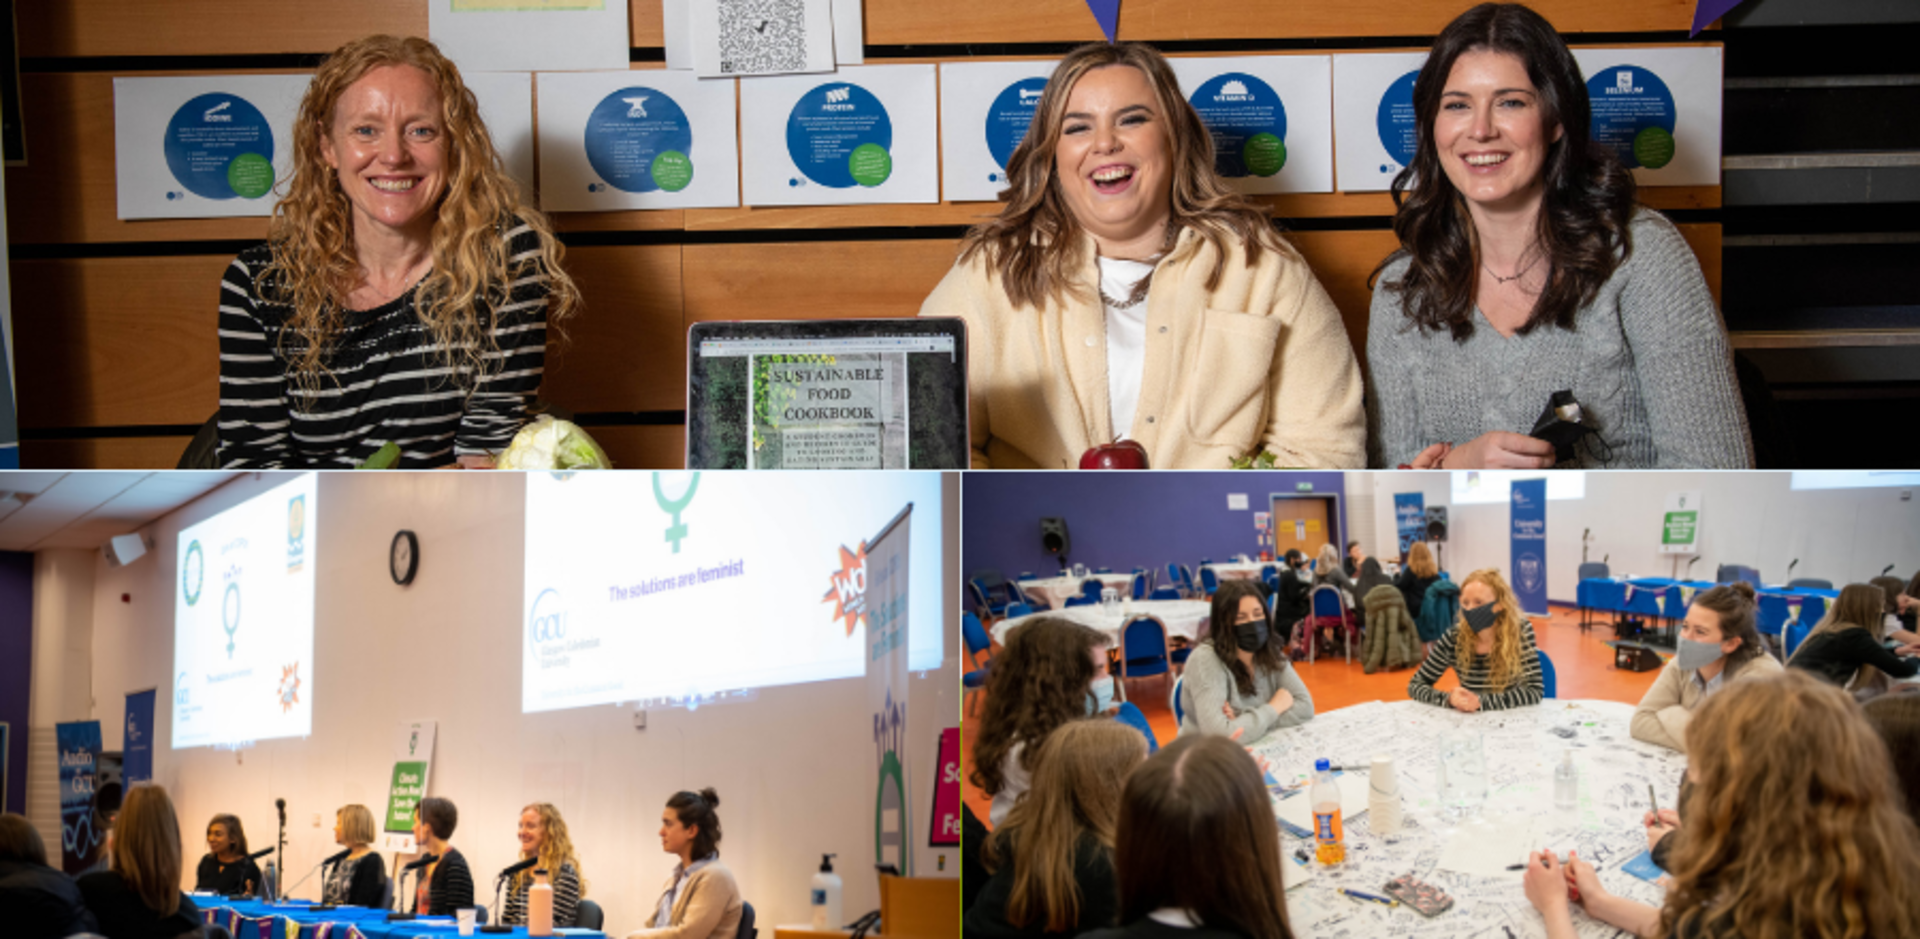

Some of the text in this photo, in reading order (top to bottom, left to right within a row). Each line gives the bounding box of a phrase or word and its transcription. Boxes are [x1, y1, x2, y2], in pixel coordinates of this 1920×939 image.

[774, 368, 884, 383] SUSTAINABLE
[808, 388, 851, 400] FOOD
[784, 406, 875, 420] COOKBOOK
[609, 558, 744, 601] The solutions are feminist
[533, 611, 567, 642] GCU
